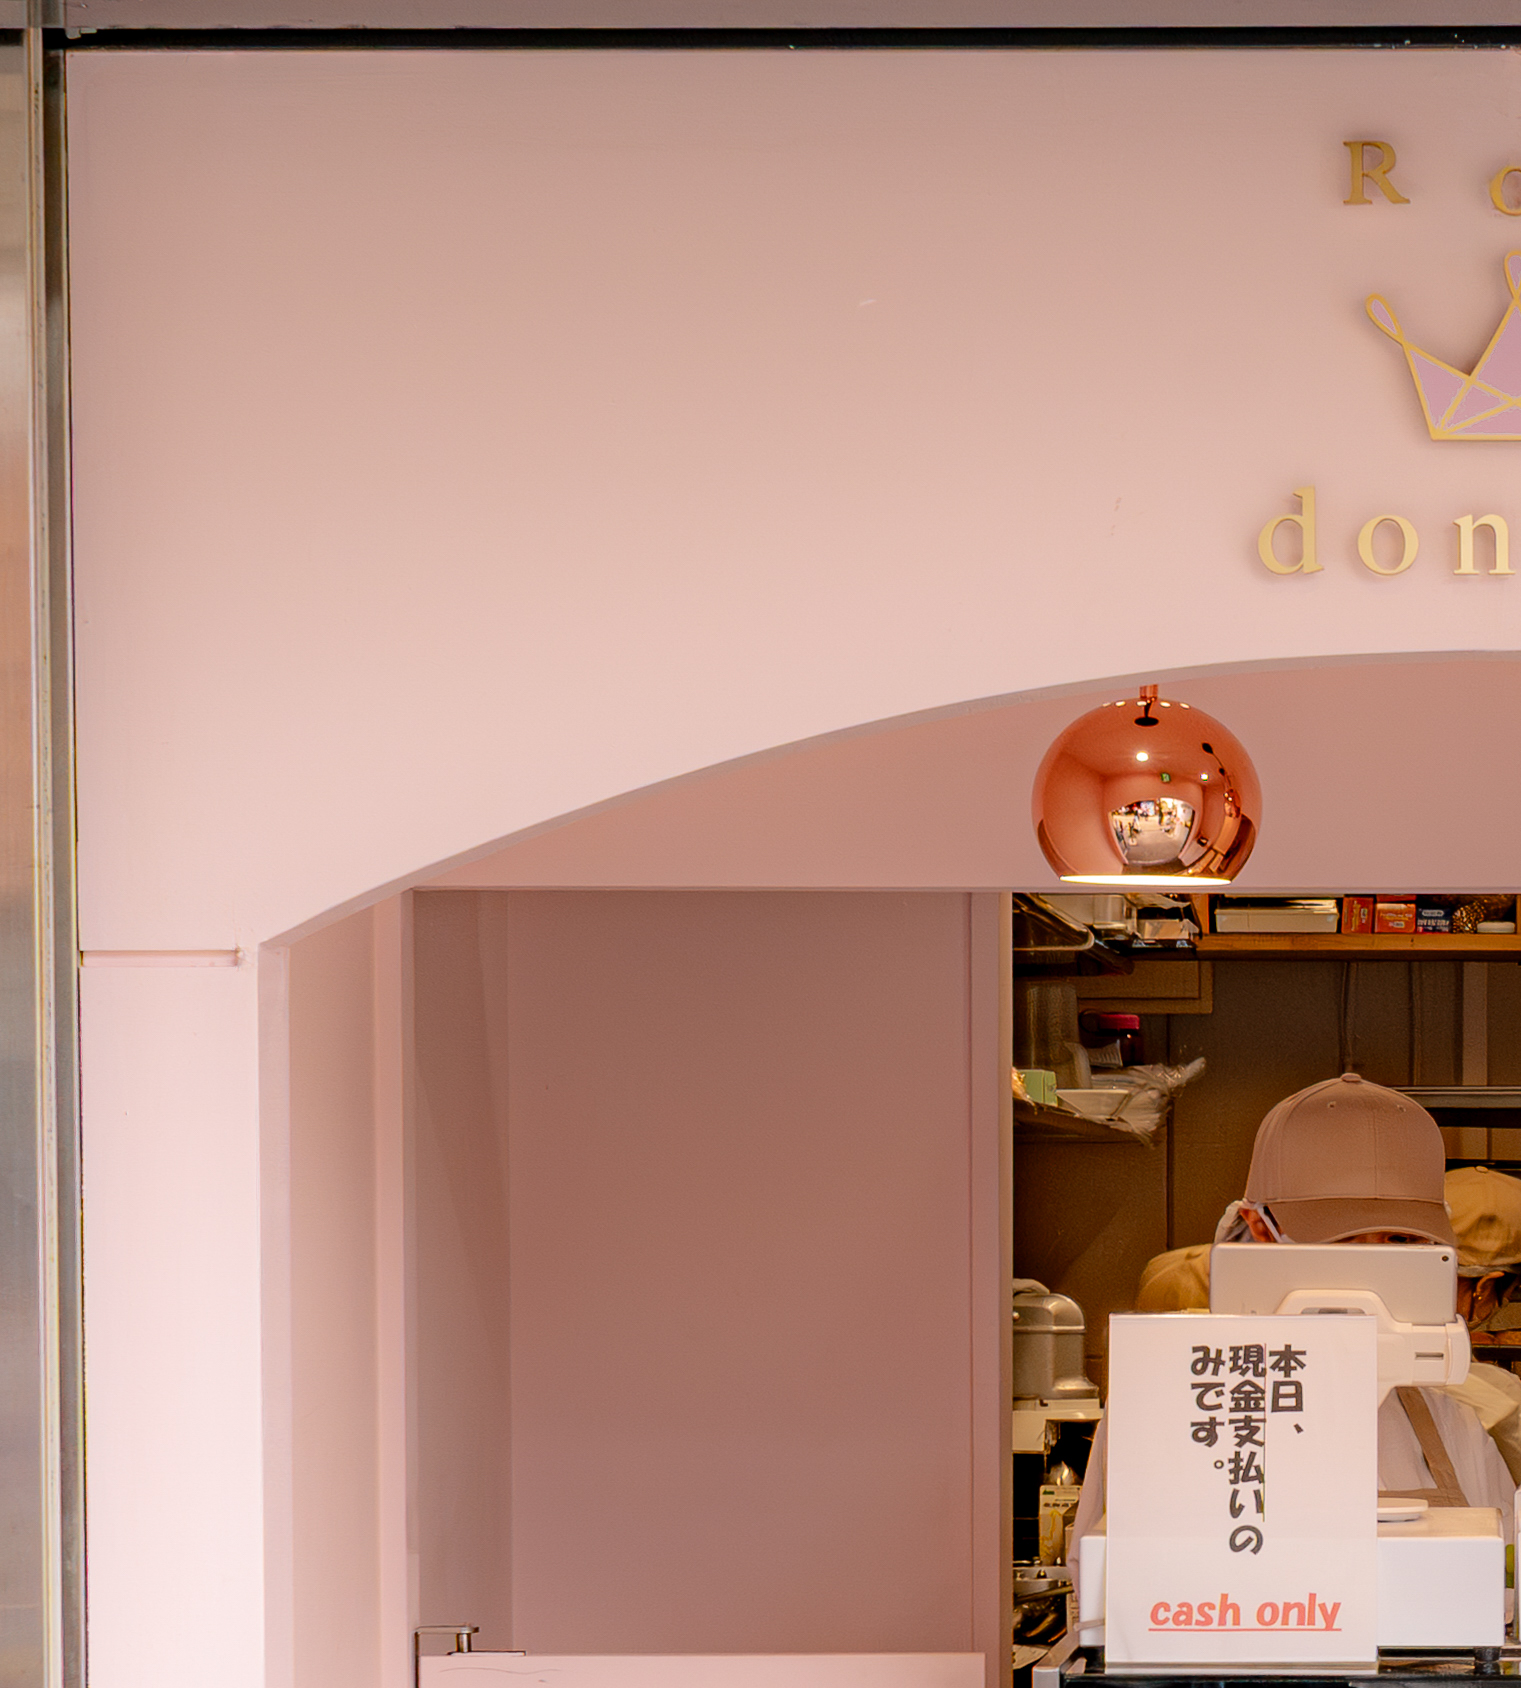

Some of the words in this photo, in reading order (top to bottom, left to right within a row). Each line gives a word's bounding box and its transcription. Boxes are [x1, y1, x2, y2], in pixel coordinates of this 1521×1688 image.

[1190, 1345, 1226, 1470] みです。
[1269, 1344, 1307, 1434] 本日、
[1228, 1344, 1267, 1555] 現金支払いの
[1149, 1592, 1242, 1628] cash
[1255, 1592, 1342, 1630] only
